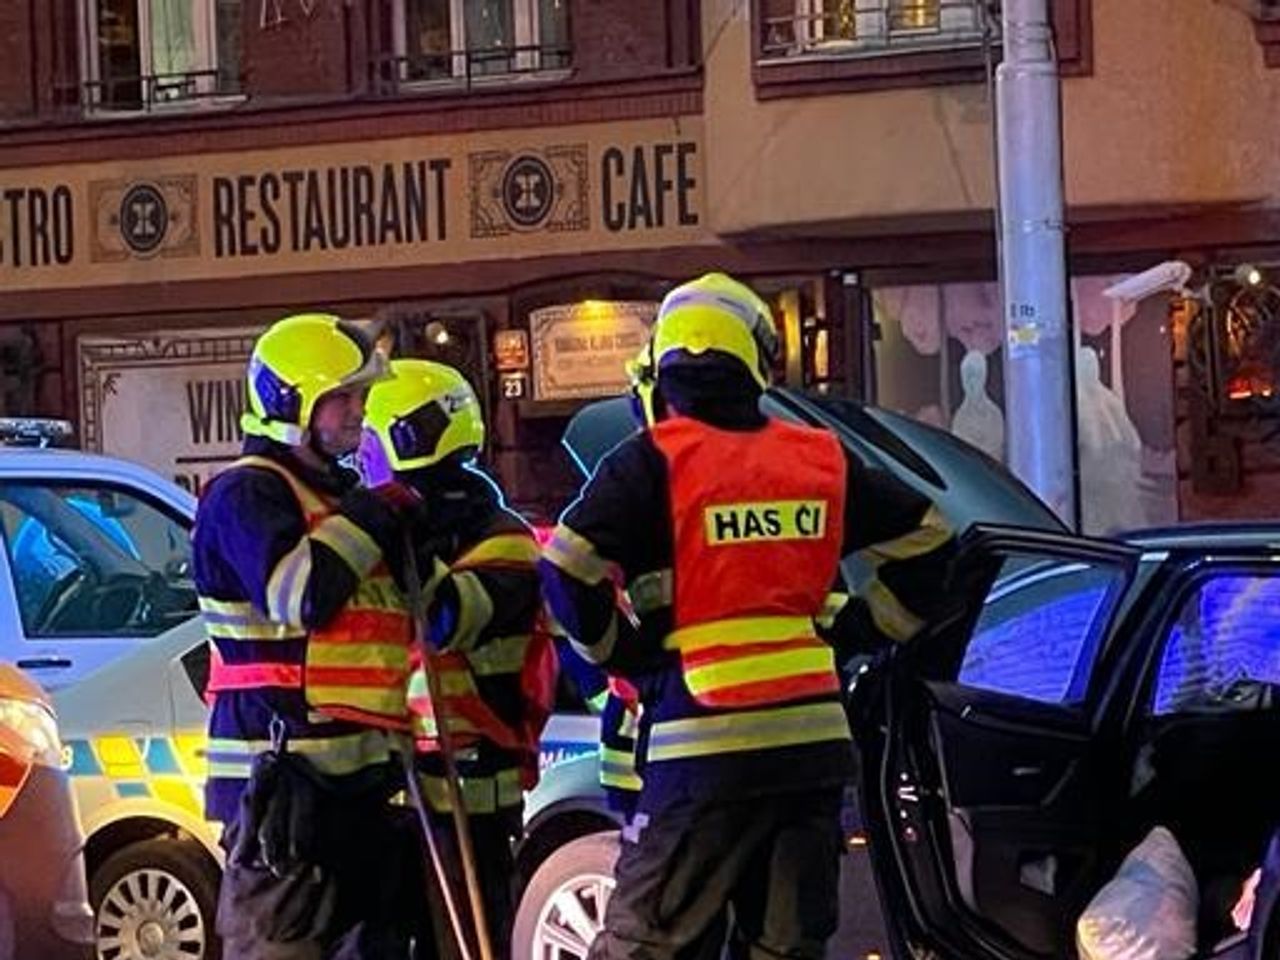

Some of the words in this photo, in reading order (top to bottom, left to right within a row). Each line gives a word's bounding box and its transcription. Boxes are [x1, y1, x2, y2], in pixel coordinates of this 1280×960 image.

[0, 185, 74, 268] TRO
[213, 157, 452, 258] RESTAURANT
[602, 142, 698, 232] CAFE
[504, 379, 523, 397] 23
